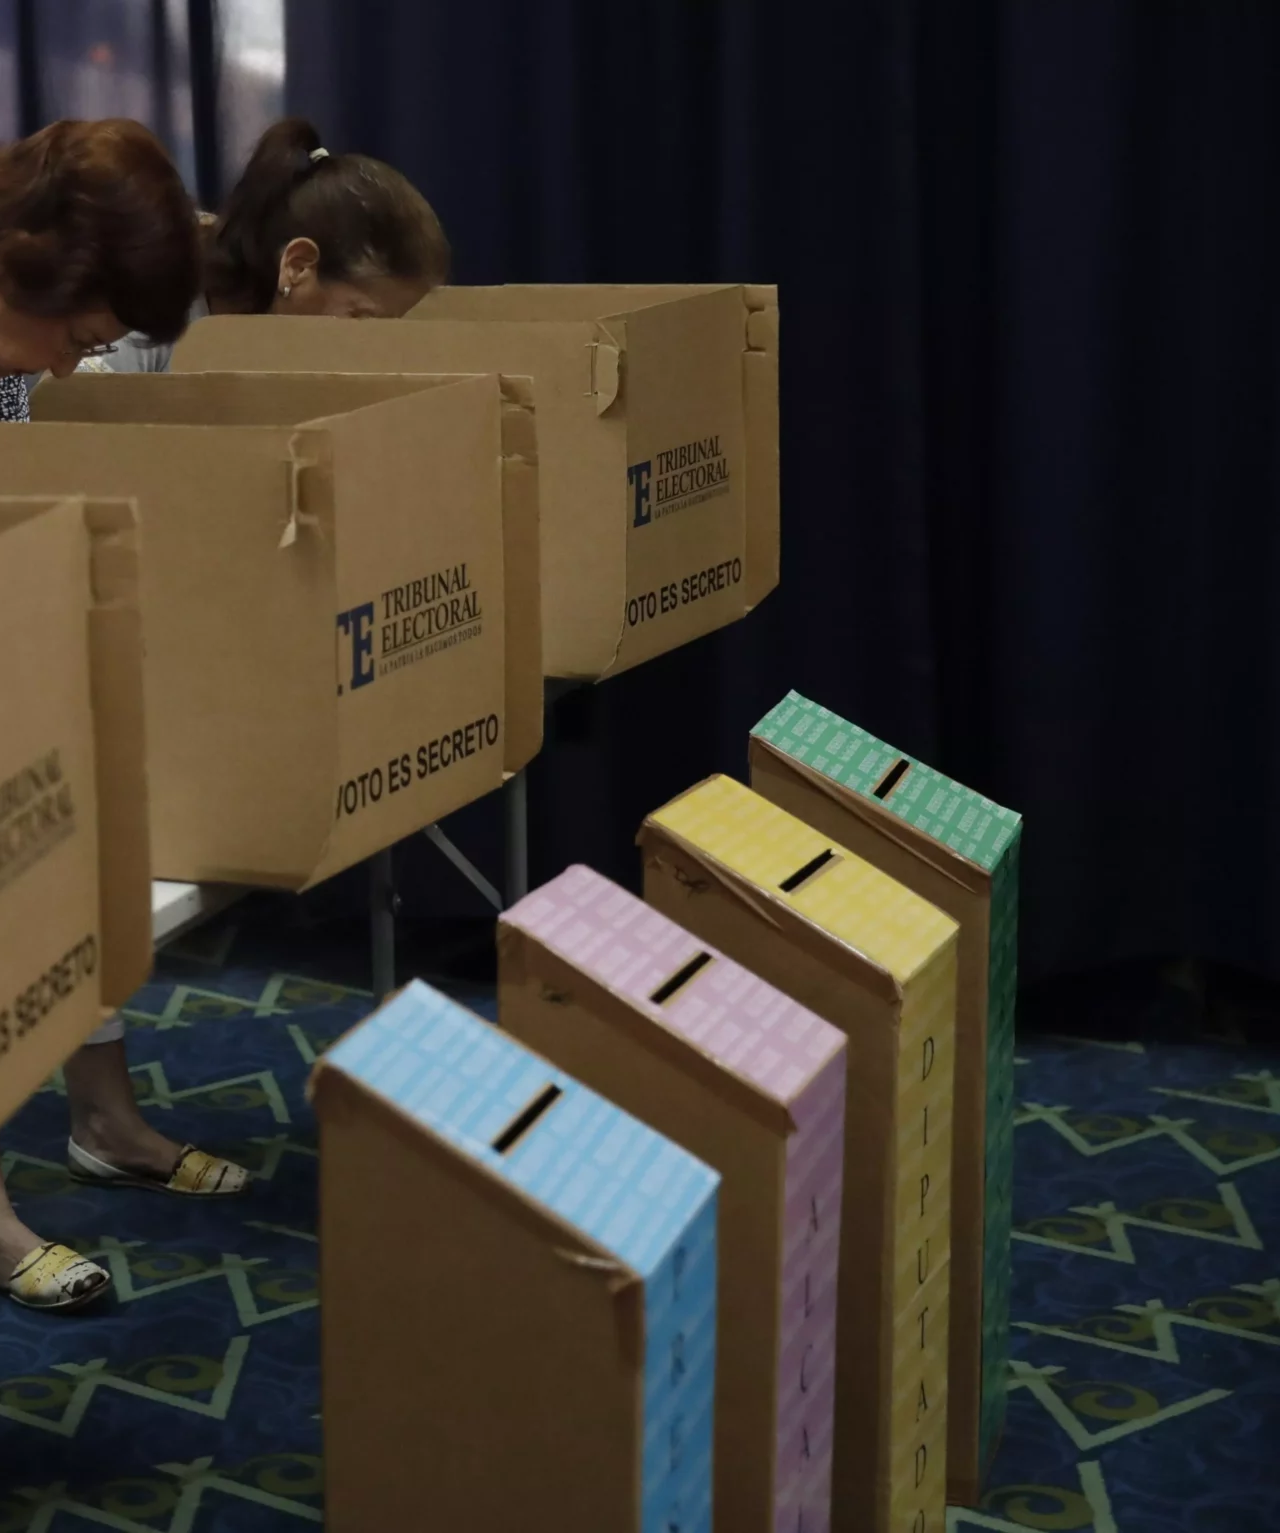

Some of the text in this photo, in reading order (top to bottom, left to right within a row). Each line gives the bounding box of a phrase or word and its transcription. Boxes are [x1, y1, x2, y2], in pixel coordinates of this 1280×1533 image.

[656, 435, 722, 475] TRIBUNAL
[656, 458, 730, 503] ELECTORAL
[381, 563, 471, 620] TRIBUNAL
[381, 591, 482, 653] ELECTORAL
[625, 558, 741, 627] OTO ES SECRETO
[389, 754, 411, 794] ES
[417, 713, 498, 780] SECRETO
[14, 932, 97, 1037] SECRETO
